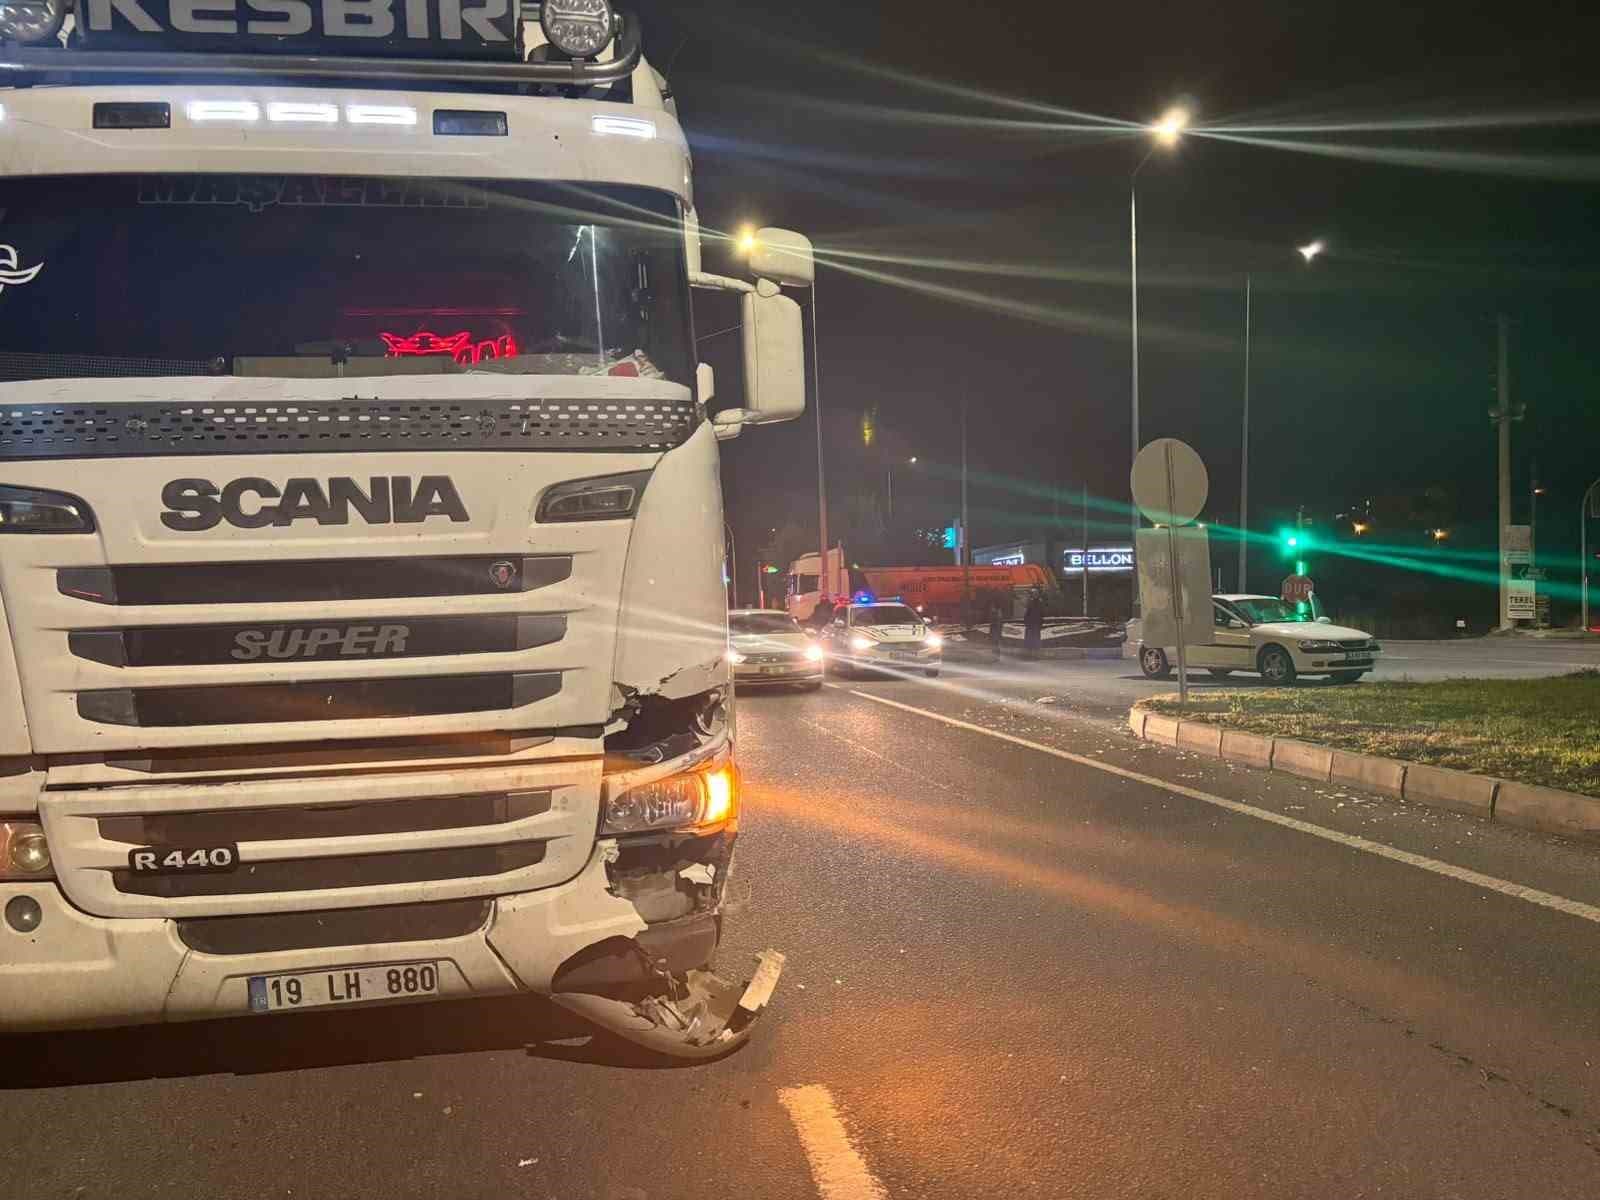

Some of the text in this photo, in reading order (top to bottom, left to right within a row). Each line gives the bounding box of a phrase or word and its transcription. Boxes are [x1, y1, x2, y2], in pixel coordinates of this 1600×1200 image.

[160, 476, 470, 532] SCANIA
[231, 624, 409, 660] SUPER
[134, 848, 232, 871] R 440
[271, 978, 302, 1007] 19
[327, 972, 362, 1001] LH
[386, 966, 435, 994] 880
